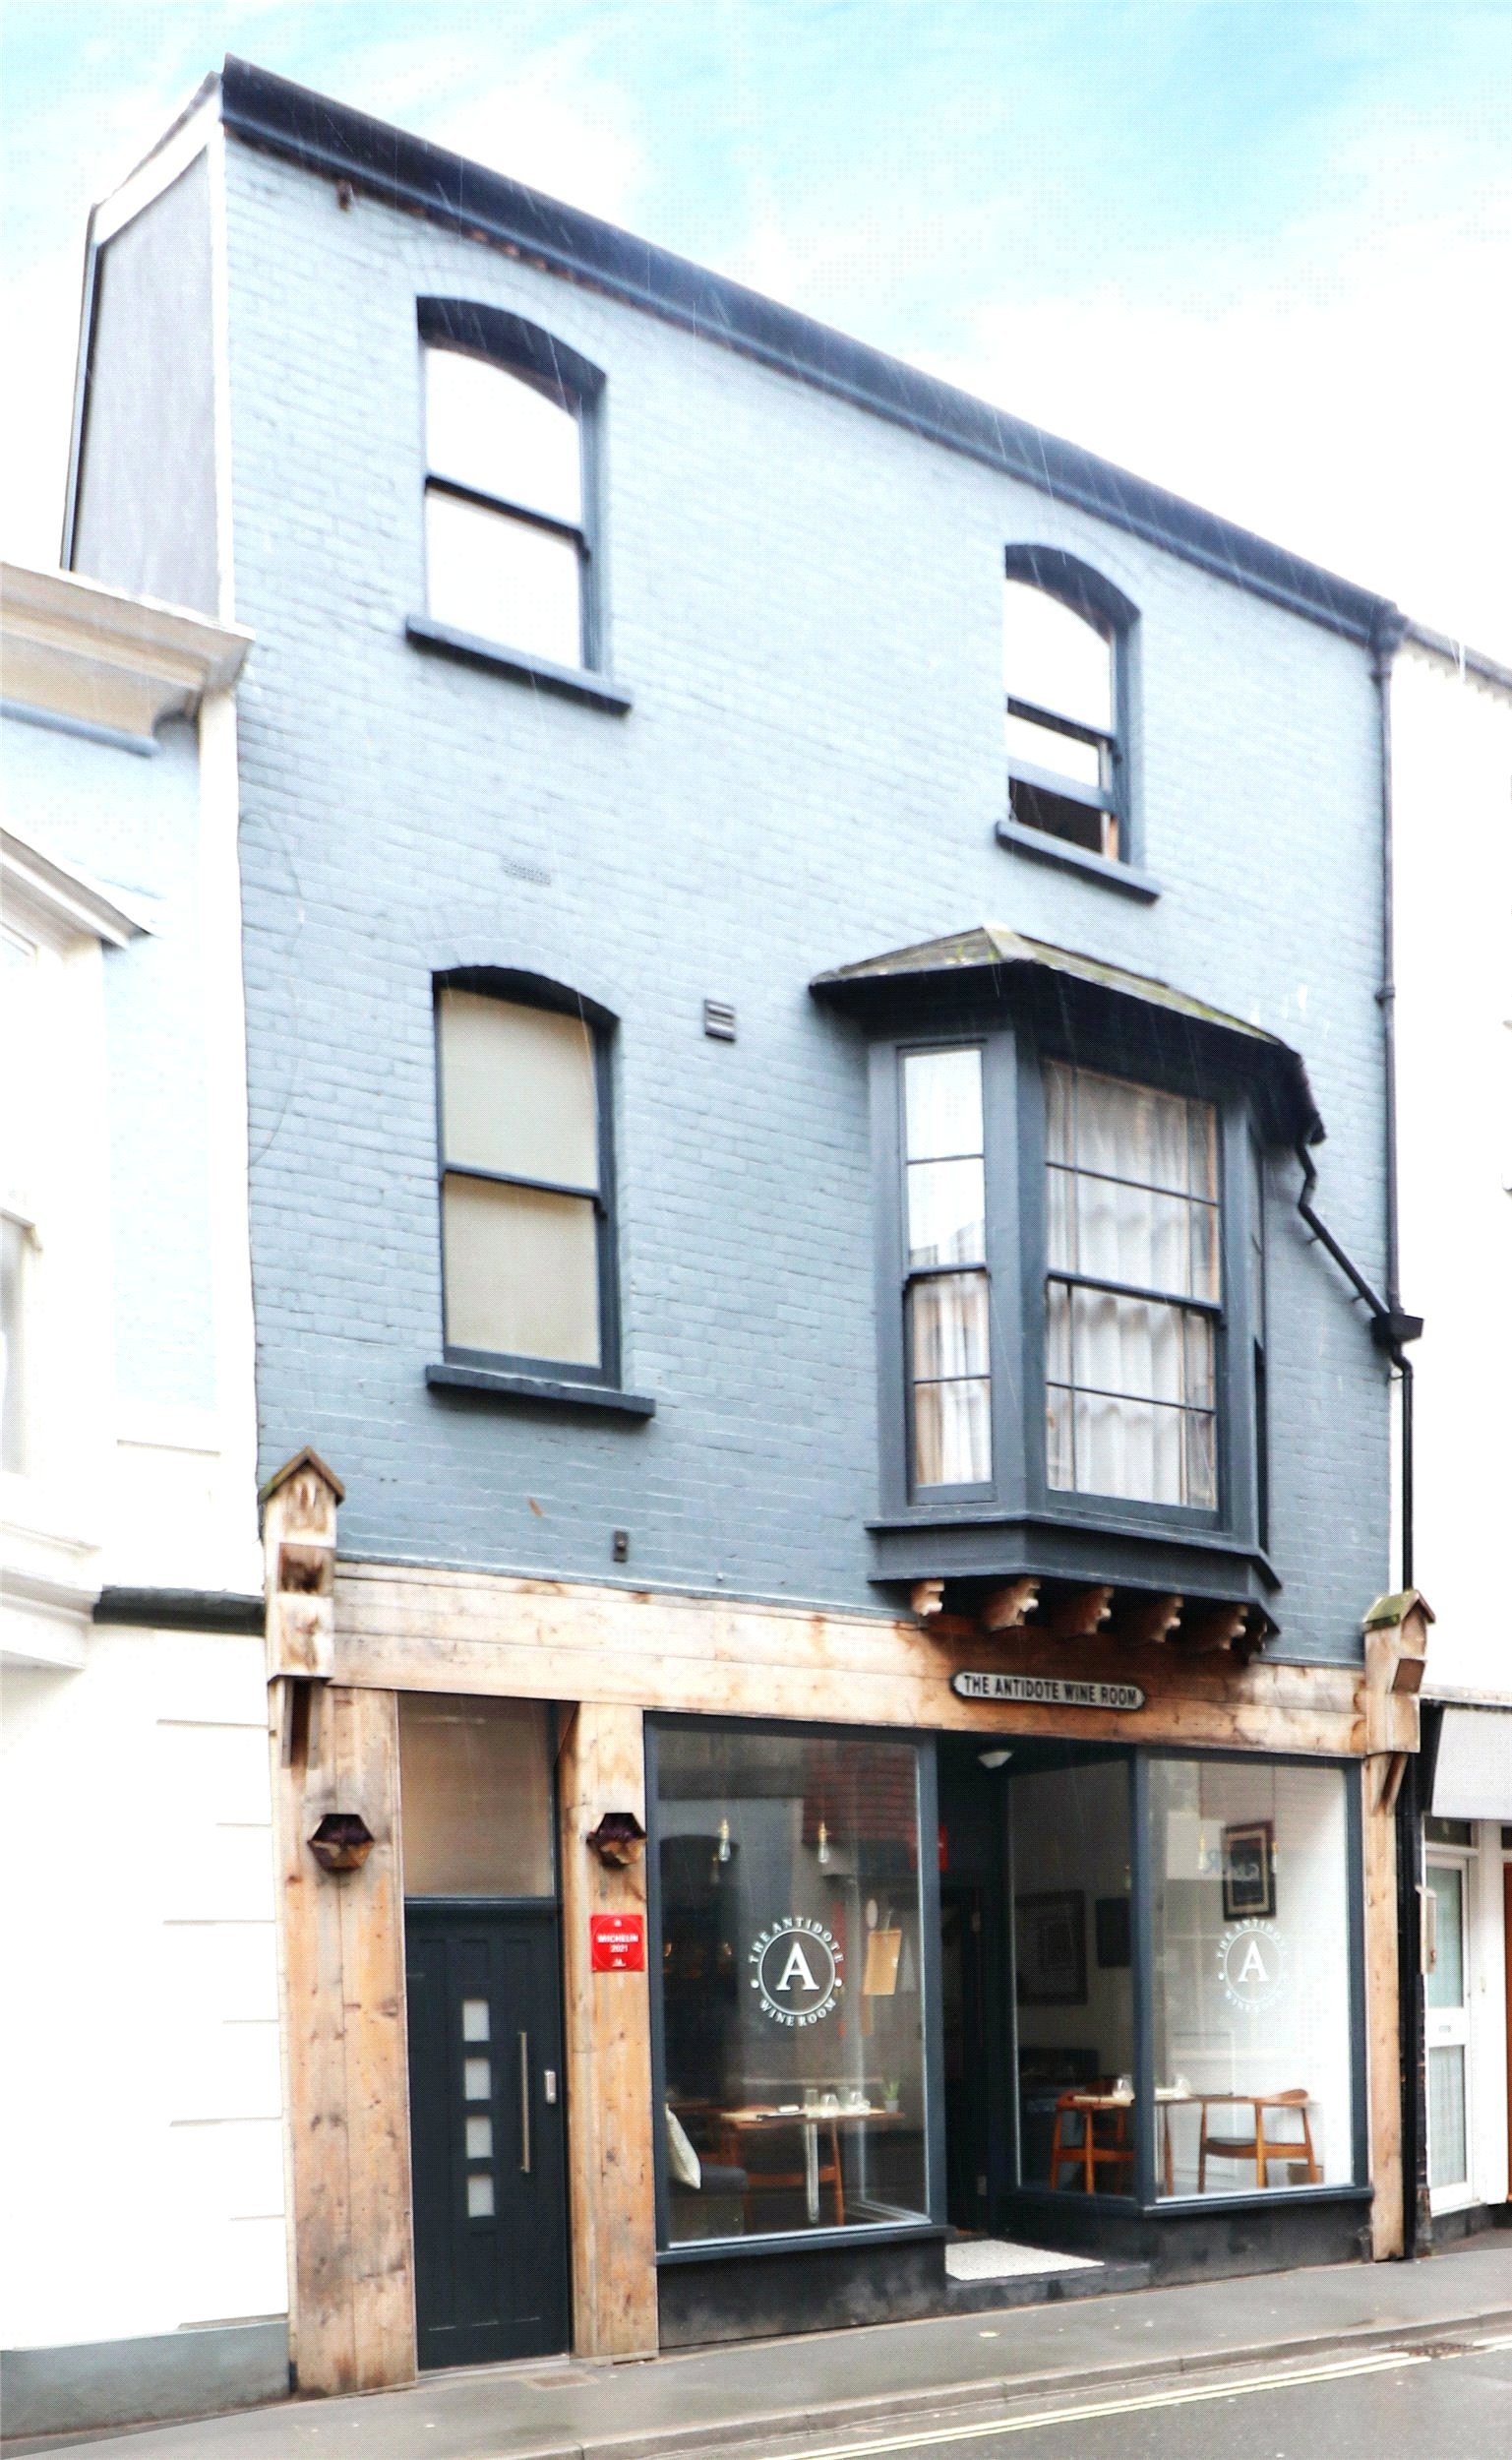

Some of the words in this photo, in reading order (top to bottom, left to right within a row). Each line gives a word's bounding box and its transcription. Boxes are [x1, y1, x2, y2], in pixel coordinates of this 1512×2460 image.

[964, 1674, 990, 1693] THE
[995, 1677, 1058, 1700] ANTIDOTE
[1063, 1683, 1096, 1703] WINE
[1101, 1687, 1137, 1705] ROOM
[596, 1934, 638, 1942] MICHELIN
[610, 1943, 629, 1953] 2021
[749, 1931, 771, 1964] THE
[772, 1916, 844, 1964] ANTIDOTE
[775, 1940, 820, 1991] A
[1238, 1939, 1270, 1983] A
[759, 1999, 795, 2027] WINE
[798, 1997, 836, 2027] ROOM
